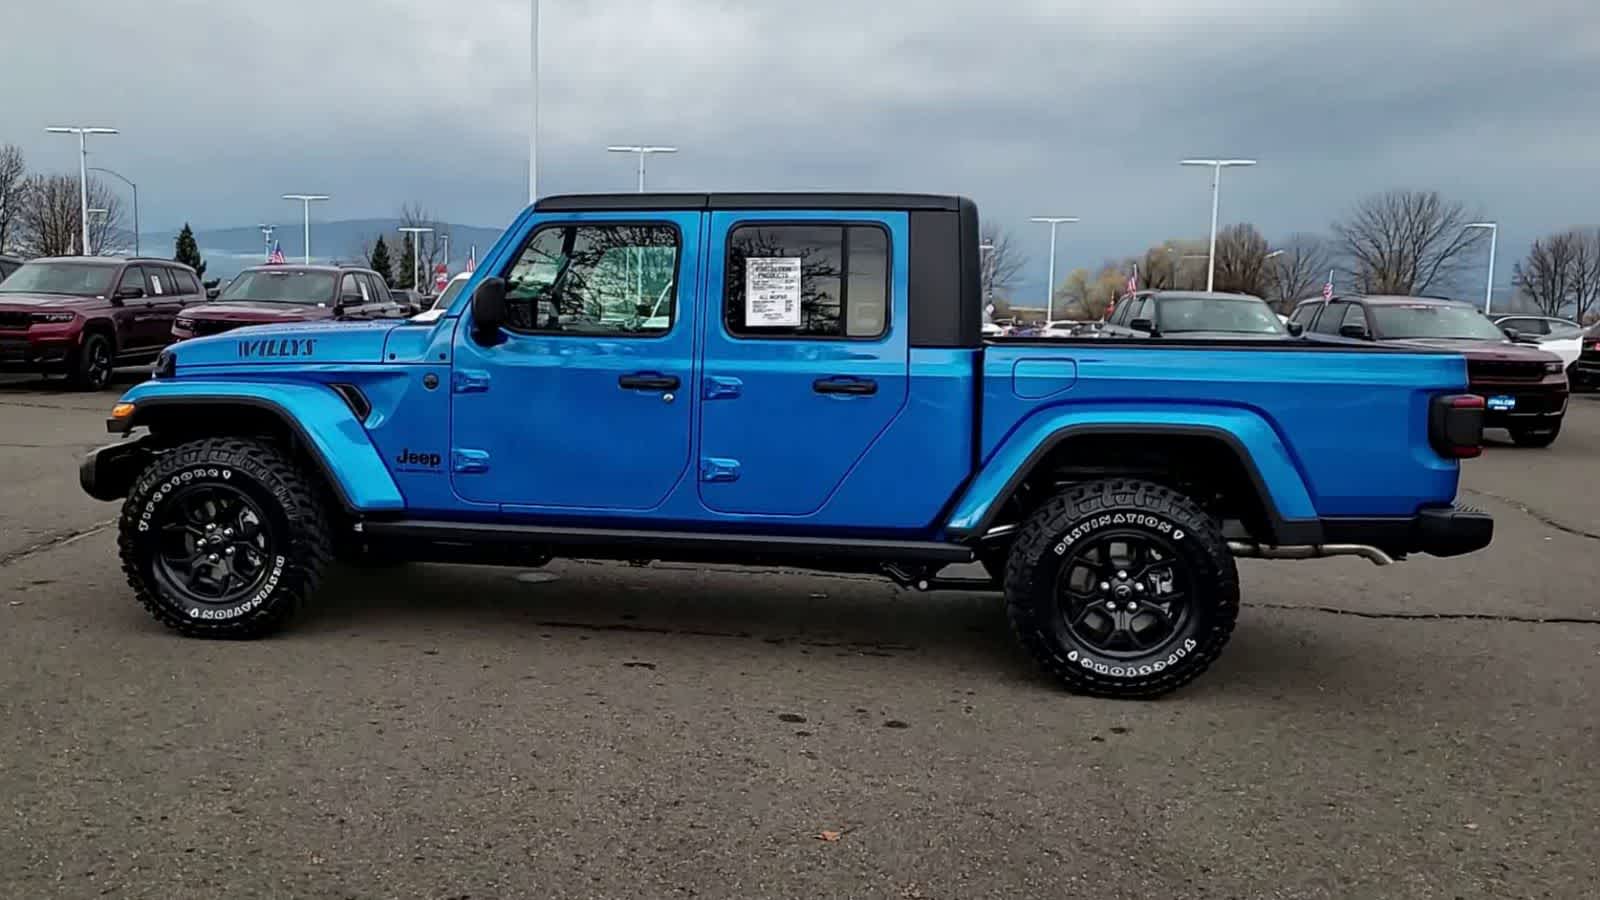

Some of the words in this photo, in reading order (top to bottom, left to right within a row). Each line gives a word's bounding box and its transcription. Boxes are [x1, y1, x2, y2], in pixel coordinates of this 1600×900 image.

[238, 339, 318, 357] WILLYS
[396, 448, 441, 468] Jeep
[1054, 513, 1172, 555] DESTINATION
[202, 555, 286, 620] DESTINATION
